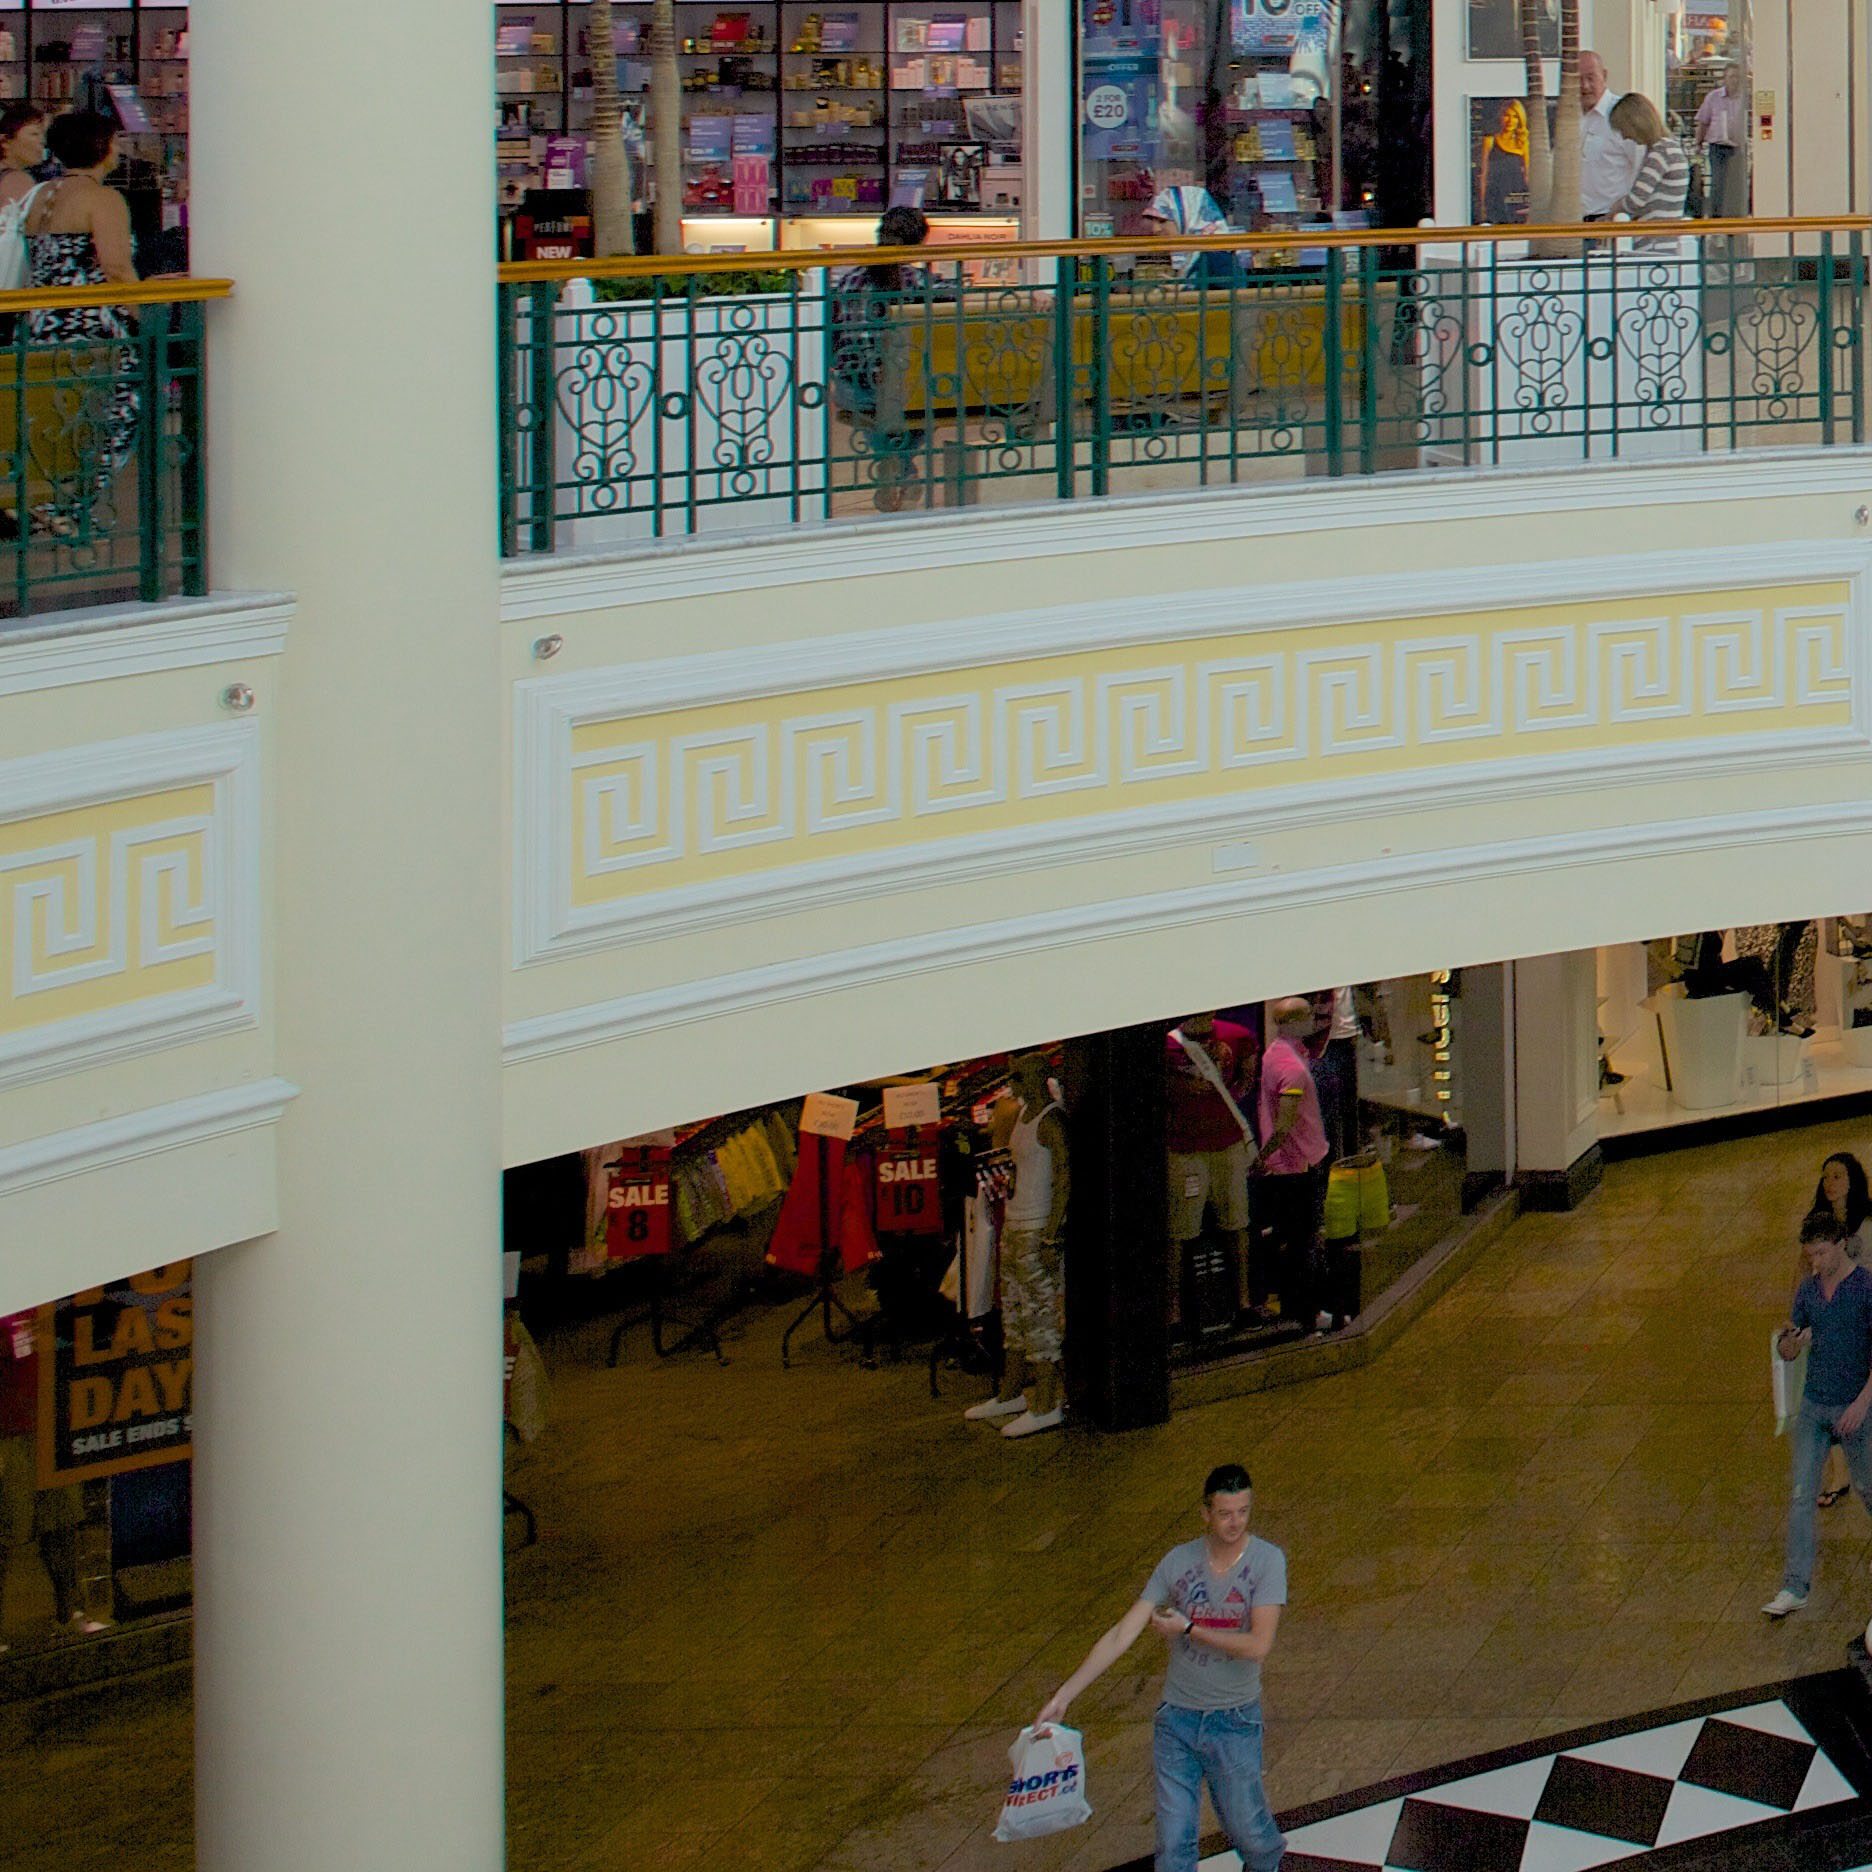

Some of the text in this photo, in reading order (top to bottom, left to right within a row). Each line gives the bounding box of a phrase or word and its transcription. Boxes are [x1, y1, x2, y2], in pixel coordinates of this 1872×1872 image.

[1294, 3, 1321, 17] OFF
[1093, 104, 1124, 119] £20
[536, 245, 572, 260] NEW
[880, 1158, 938, 1183] SALE
[609, 1184, 669, 1209] SALE
[72, 1416, 181, 1455] SALE ENDS
